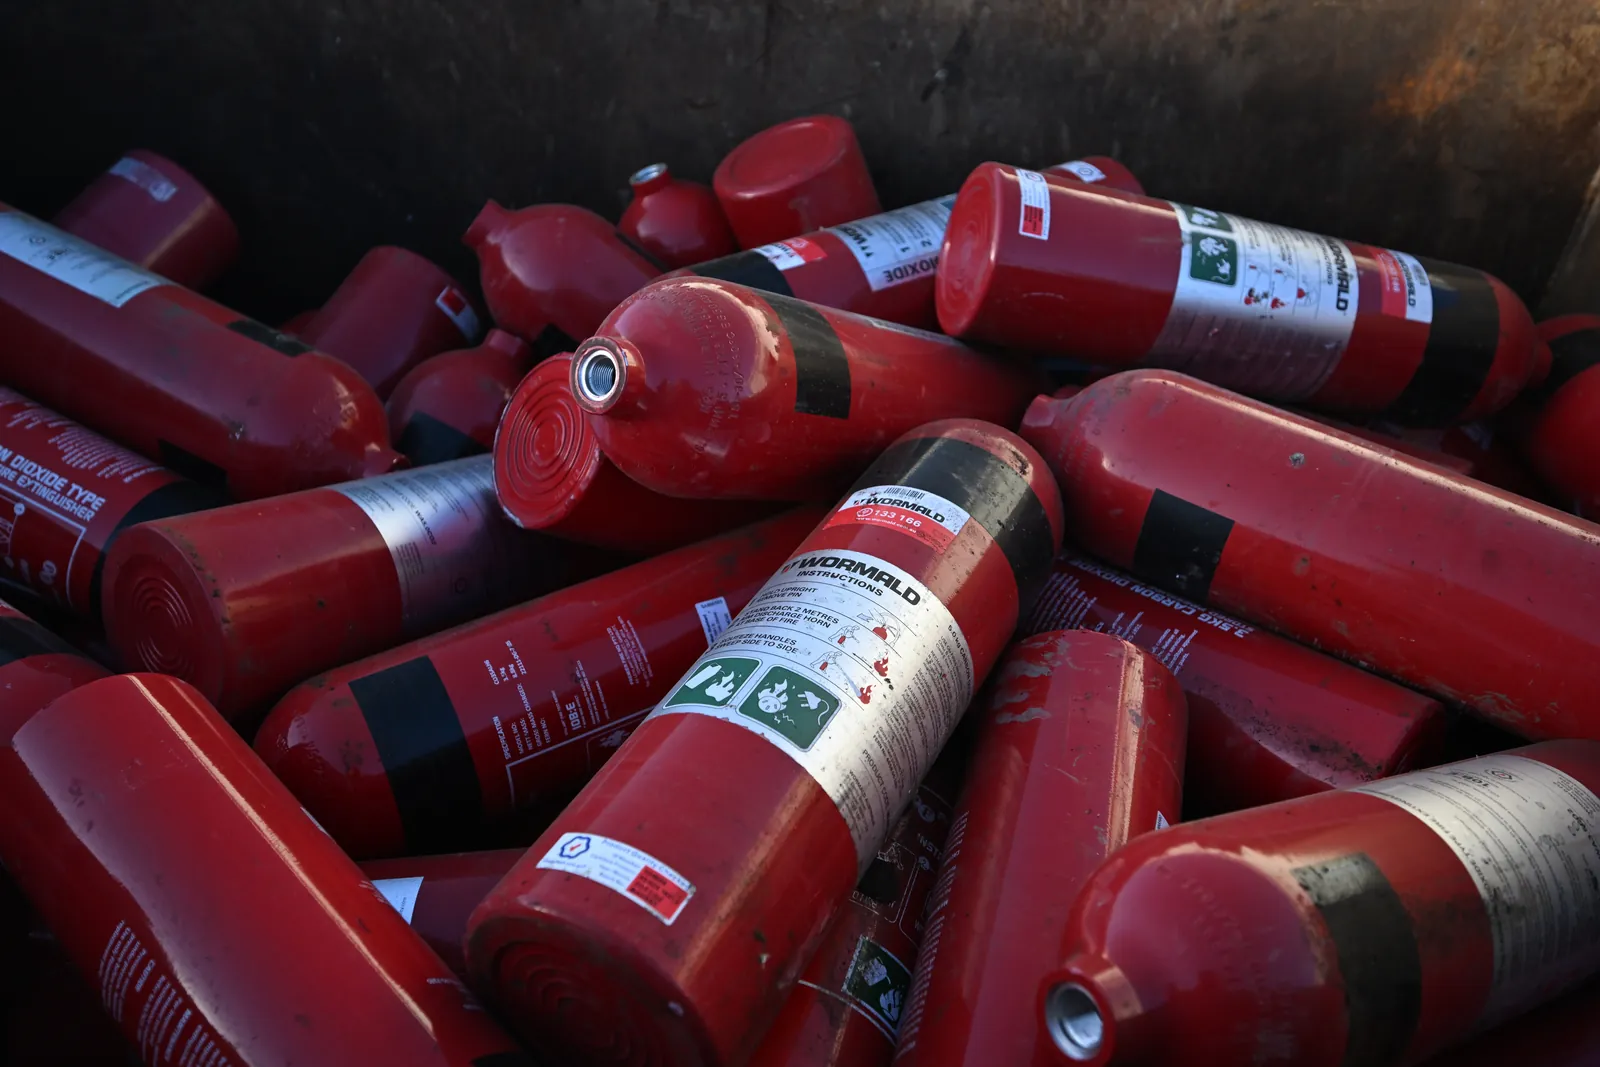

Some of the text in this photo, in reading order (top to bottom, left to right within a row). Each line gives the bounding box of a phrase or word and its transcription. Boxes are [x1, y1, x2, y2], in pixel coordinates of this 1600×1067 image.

[9, 453, 68, 491] DIOXIDE
[65, 482, 106, 511] TYPE
[15, 474, 96, 522] EXTINGUISHER
[865, 496, 945, 523] WORMALD
[873, 508, 922, 527] 133 166
[796, 570, 883, 596] INSTRUCTIONS
[798, 556, 920, 605] WORMALD
[1129, 581, 1197, 617] CARBON
[753, 609, 802, 619] DISCHARGE
[803, 615, 831, 628] HORN
[770, 603, 794, 611] BACK
[802, 607, 839, 624] METRES
[780, 617, 798, 625] FIRE
[1197, 610, 1247, 639] 3.5KG
[753, 631, 797, 645] HANDLES
[763, 640, 776, 648] TO
[775, 642, 799, 654] SIDE
[947, 624, 957, 637] 5.0
[954, 637, 961, 648] kg
[516, 682, 530, 711] CHARGED:
[526, 711, 536, 728] MASS
[492, 715, 511, 759] SPECIFICATION
[532, 728, 542, 746] GROSS
[861, 749, 884, 786] PRODUCT
[1428, 816, 1449, 834] FIRE
[1448, 833, 1470, 857] TYPE
